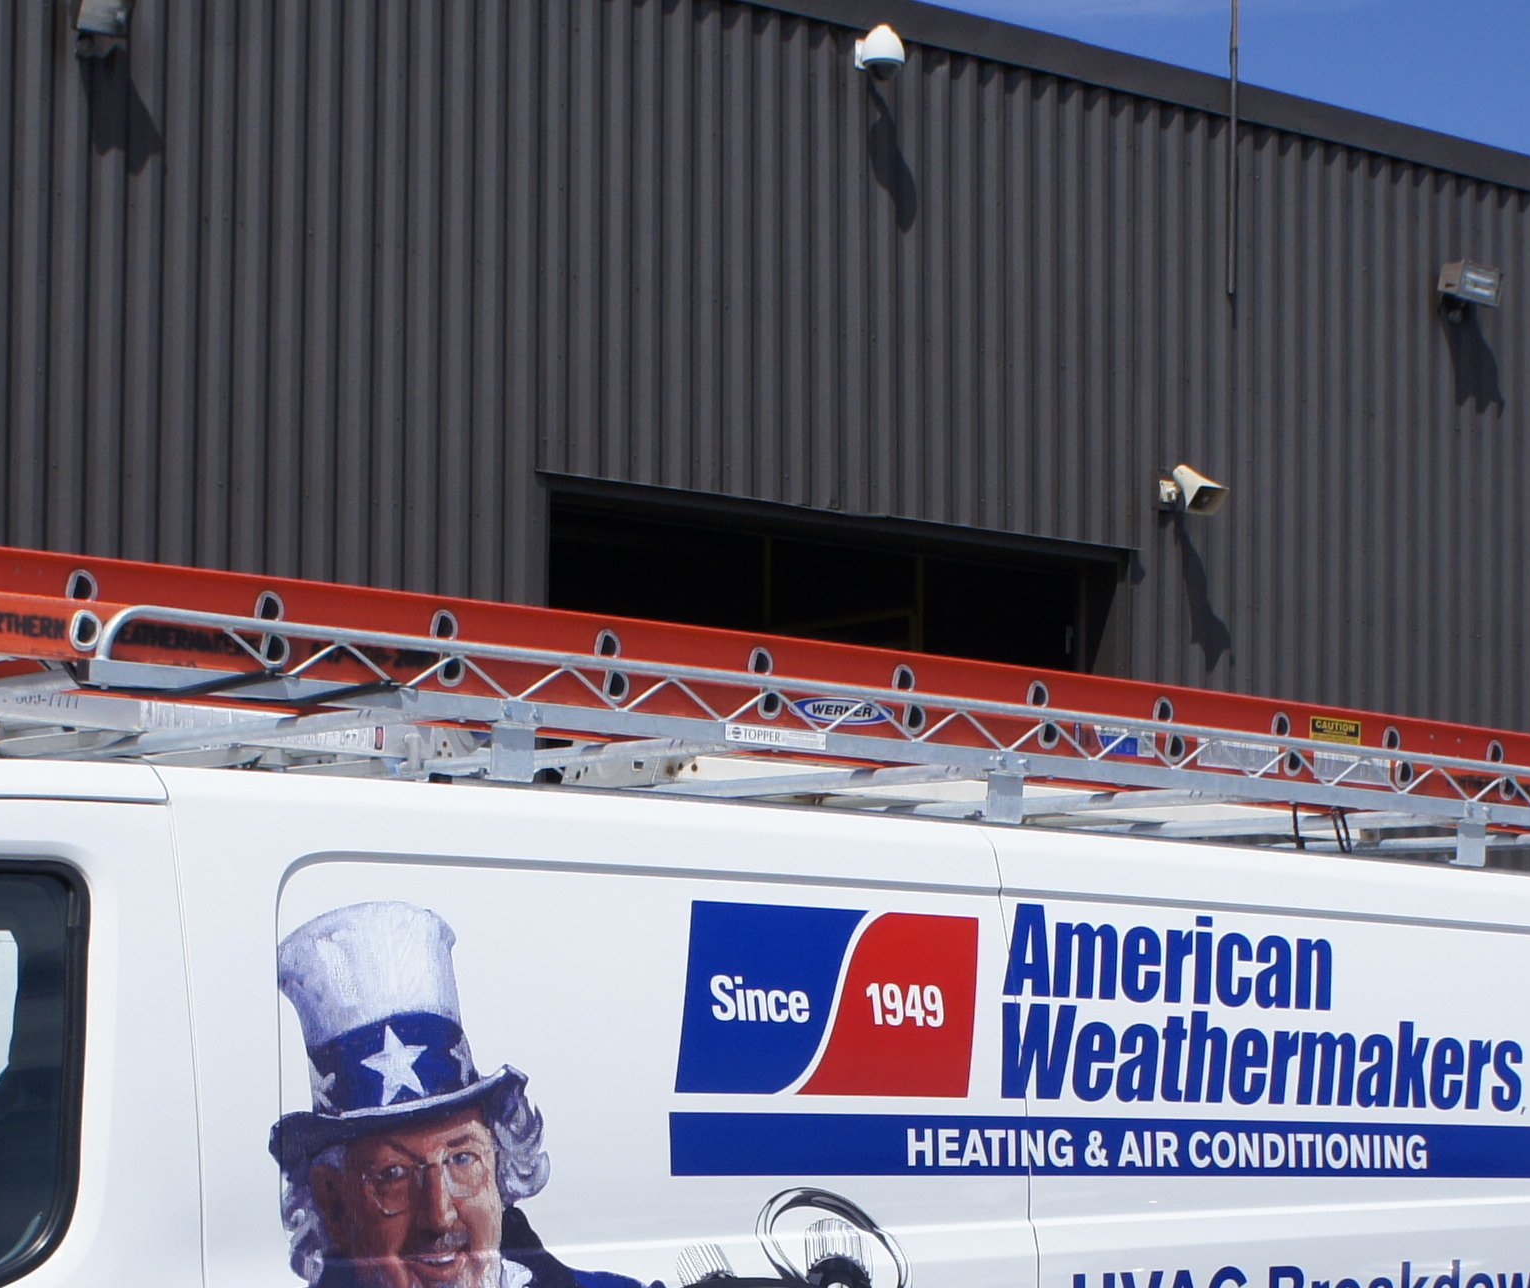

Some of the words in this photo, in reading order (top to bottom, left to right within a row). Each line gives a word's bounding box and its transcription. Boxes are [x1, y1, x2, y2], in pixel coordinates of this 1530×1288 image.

[811, 703, 874, 718] WERNER
[1315, 720, 1356, 733] CAUTION
[743, 728, 781, 743] TOPPER
[1003, 901, 1333, 1012] American
[710, 973, 811, 1026] Since
[865, 981, 945, 1029] 1949
[906, 1126, 1075, 1168] HEATING
[1084, 1130, 1112, 1168] &
[1118, 1131, 1179, 1168] AIR
[1188, 1131, 1429, 1170] CONDITIONING
